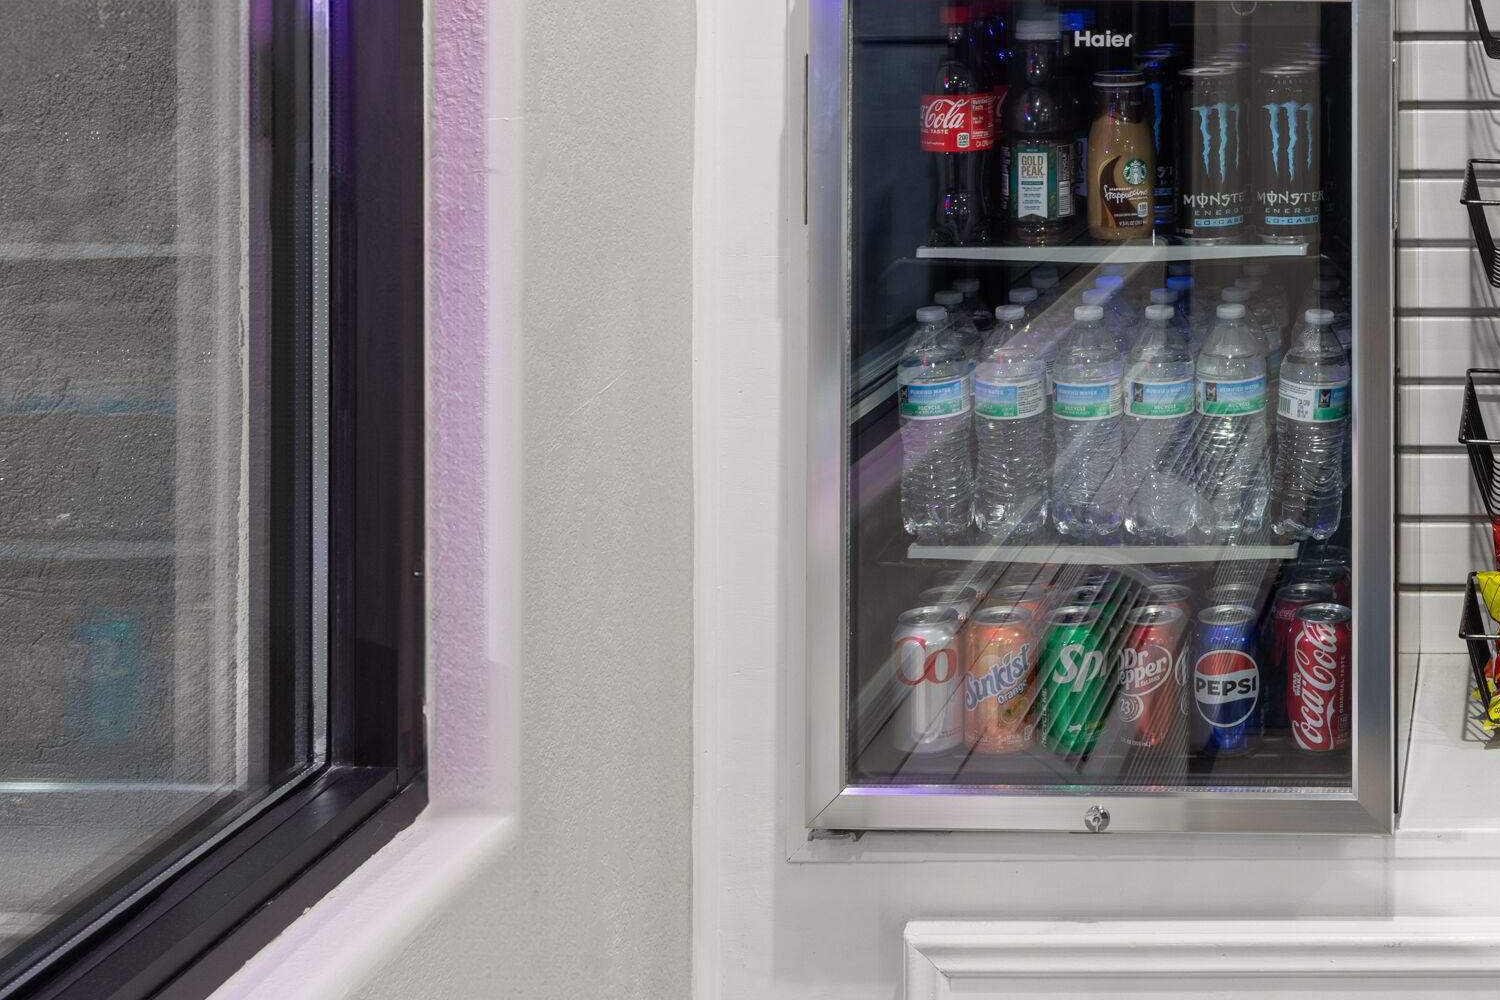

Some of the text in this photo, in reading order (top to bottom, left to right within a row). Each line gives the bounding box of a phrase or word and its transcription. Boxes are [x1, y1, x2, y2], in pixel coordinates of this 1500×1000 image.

[1074, 29, 1133, 48] Haier
[1021, 155, 1044, 166] GOLD
[1021, 166, 1044, 176] PEAK
[1183, 192, 1245, 208] MONSTE
[1256, 190, 1325, 207] MONSTER
[1265, 216, 1319, 224] LO-CARB
[1123, 647, 1149, 669] Dr
[965, 643, 1031, 711] Sunkist
[1119, 656, 1168, 690] epper
[997, 678, 1029, 705] orange
[1196, 676, 1257, 697] PEPSI
[1292, 622, 1337, 750] Coca-Cola
[1120, 698, 1131, 715] 23
